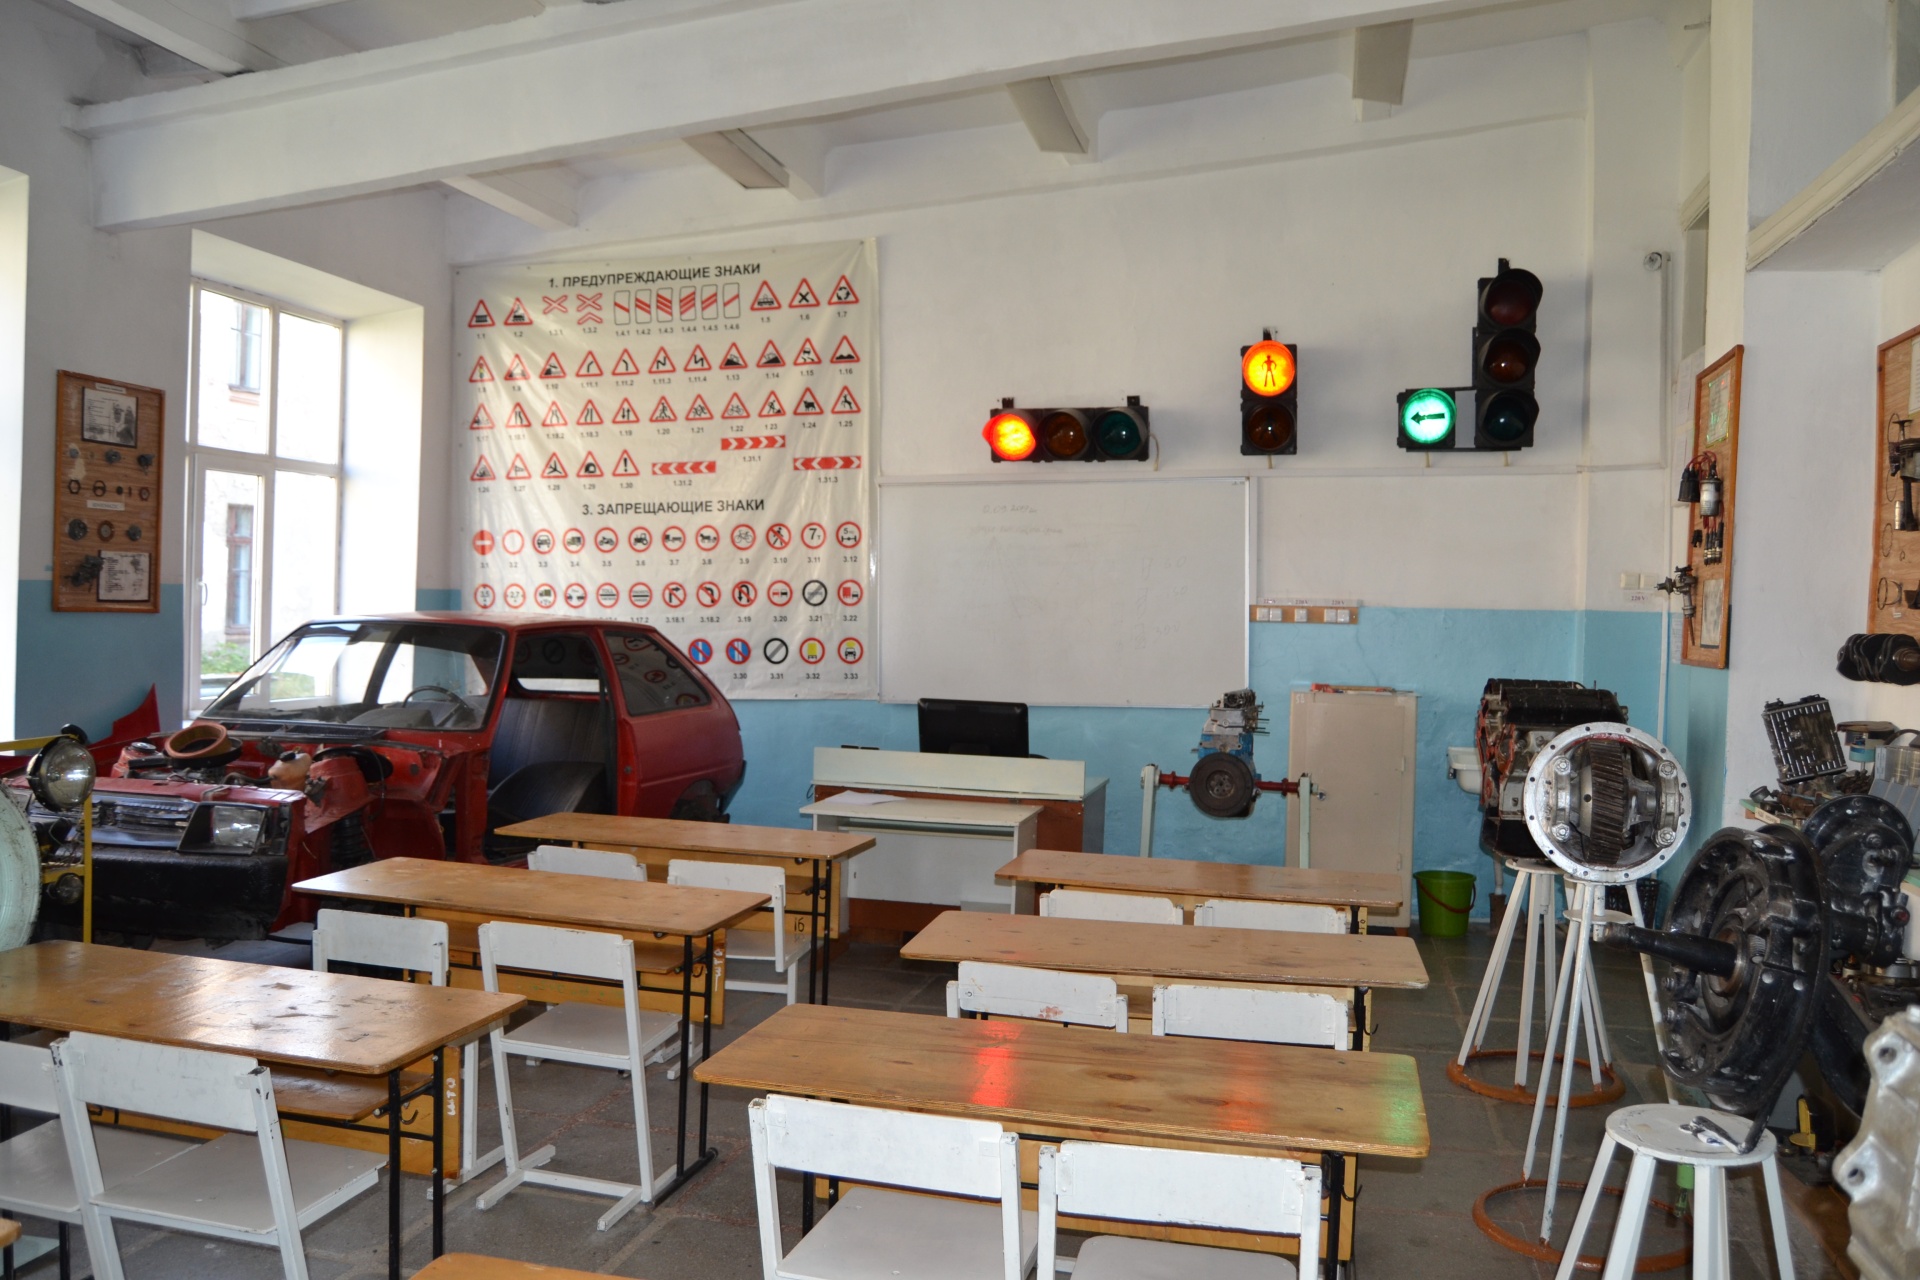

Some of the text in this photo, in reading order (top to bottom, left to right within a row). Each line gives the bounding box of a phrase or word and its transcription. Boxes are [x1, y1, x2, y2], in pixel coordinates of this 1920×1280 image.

[549, 263, 761, 288] 1. ПРЕДУПРЕЖДАЮЩИЕ ЗНАКИ
[636, 328, 651, 336] 1.4.2
[800, 369, 814, 377] 1.15
[838, 368, 853, 376] 1.16
[726, 373, 741, 381] 1.13
[615, 379, 634, 387] 1.11.2
[656, 428, 671, 436] 1.20
[730, 425, 744, 433] 1.22
[818, 476, 839, 484] 1.31.3
[581, 499, 765, 516] 3. ЗАПРЕЩАЮЩИЕ ЗНАКИ
[808, 527, 818, 541] 7
[669, 559, 680, 567] 3.7
[739, 557, 750, 565] 3.9
[773, 557, 788, 565] 3.10
[807, 556, 821, 564] 3.11
[843, 555, 858, 563] 3.12
